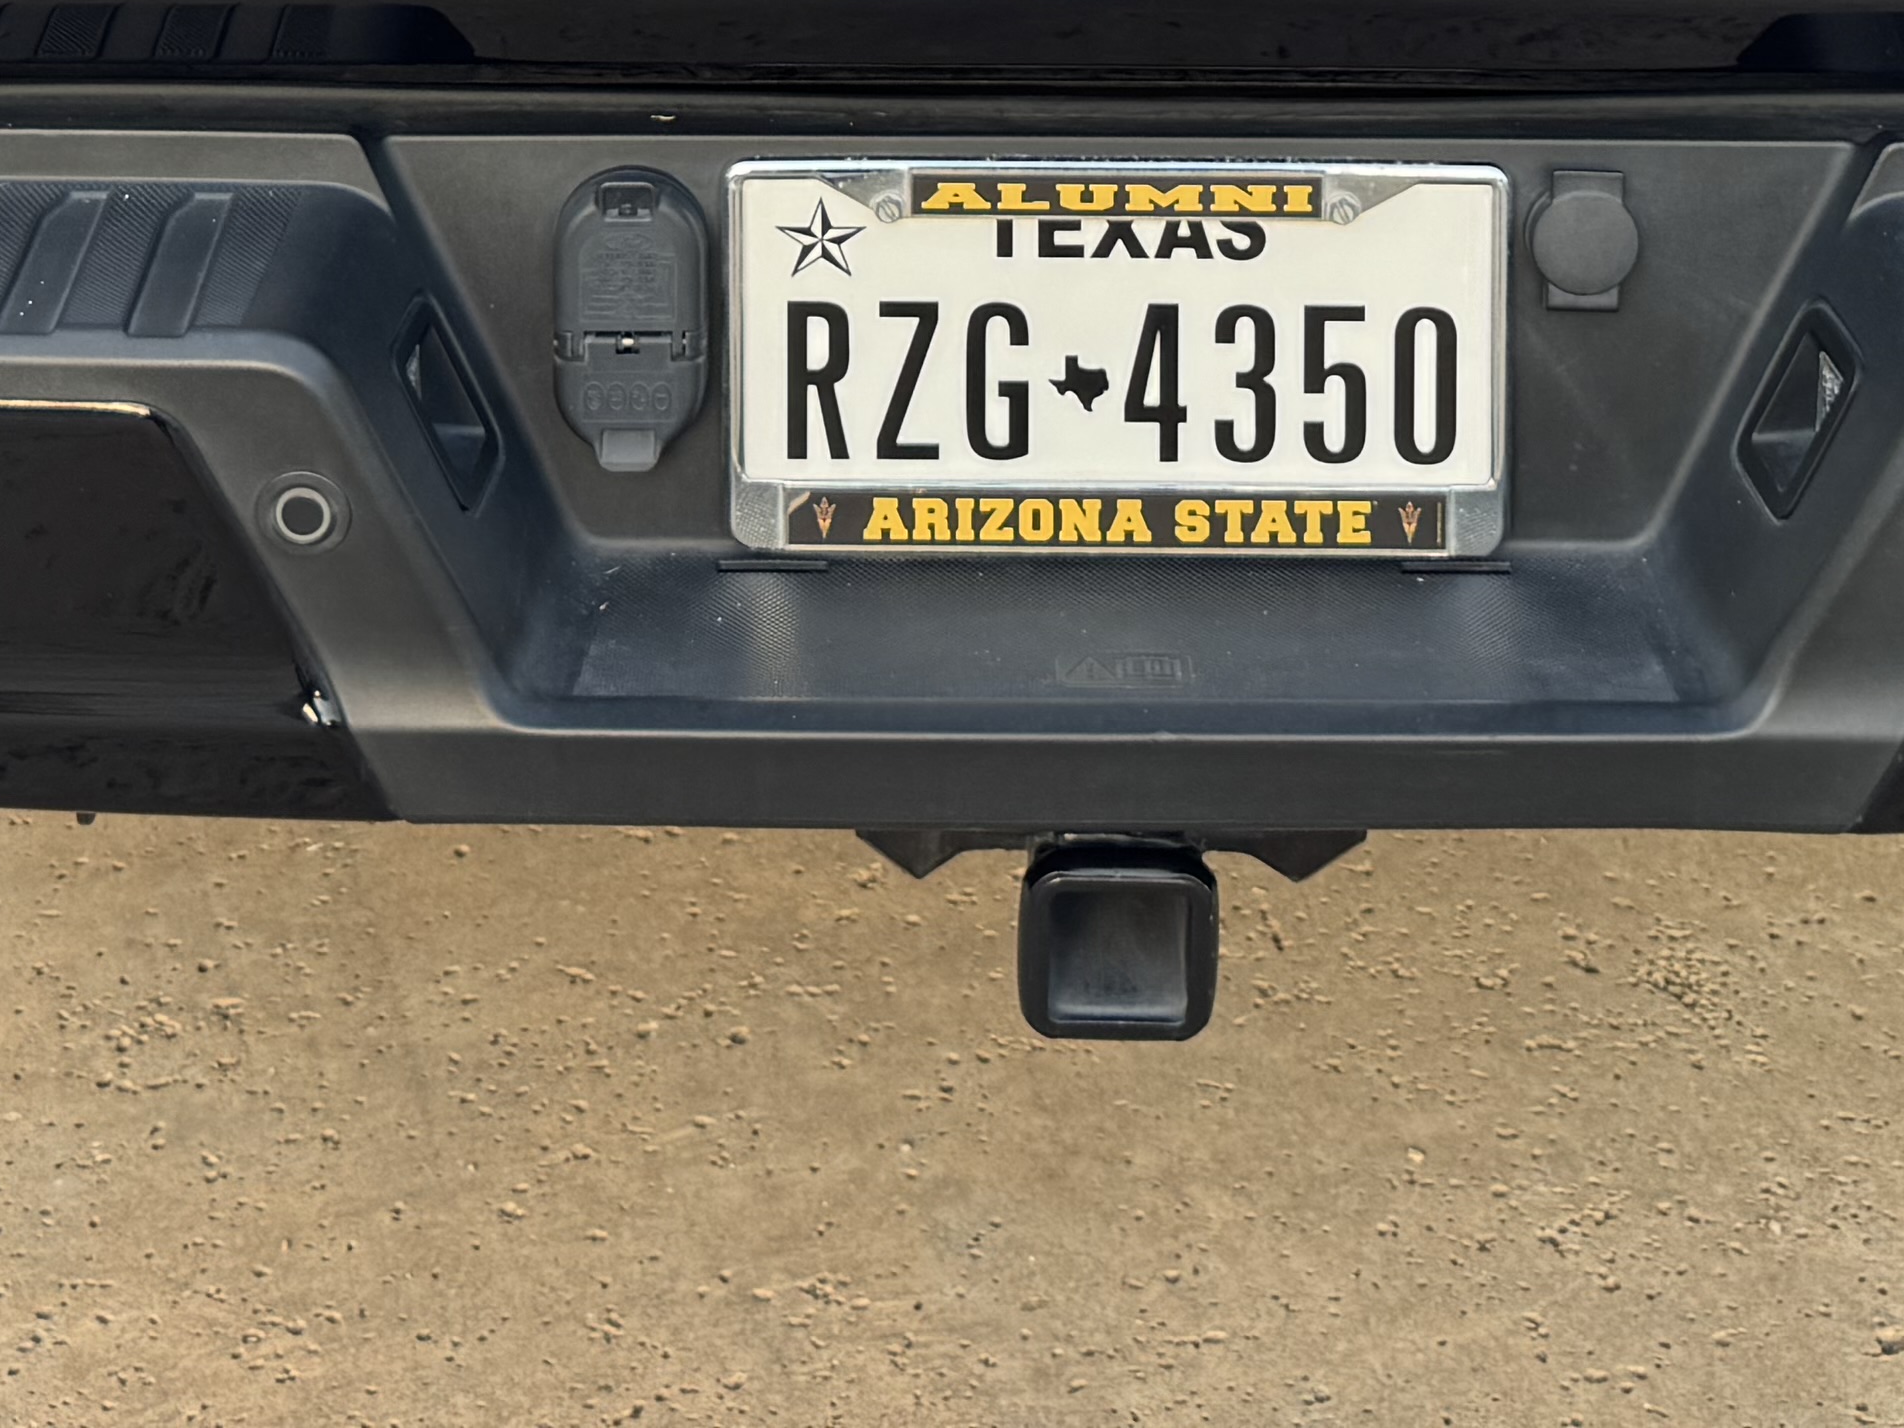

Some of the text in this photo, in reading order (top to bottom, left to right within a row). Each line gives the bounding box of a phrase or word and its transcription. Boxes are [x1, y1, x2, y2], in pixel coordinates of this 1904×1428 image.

[920, 182, 1314, 213] ALUMNI
[786, 300, 1458, 466] RZG 4350
[862, 497, 1373, 544] ARIZONA STATE
